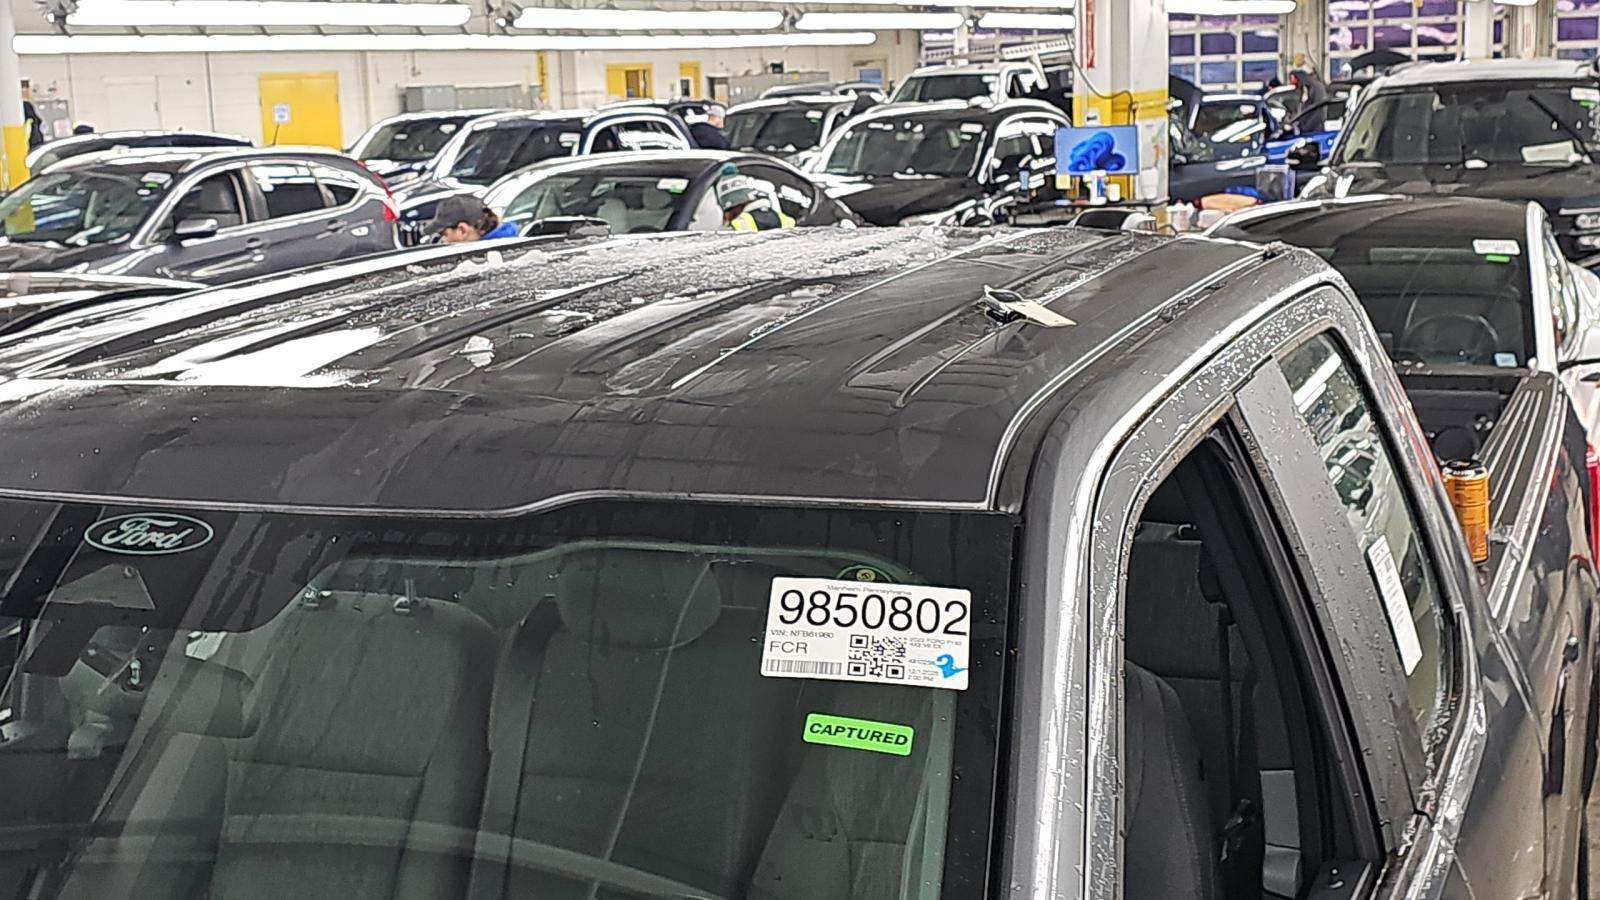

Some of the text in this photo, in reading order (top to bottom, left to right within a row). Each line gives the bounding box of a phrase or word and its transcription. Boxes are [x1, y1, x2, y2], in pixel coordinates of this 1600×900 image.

[101, 517, 194, 549] Ford
[779, 589, 968, 636] 9850802
[770, 629, 789, 637] VIN:
[769, 640, 808, 654] FCR
[809, 723, 908, 745] CAPTURED
